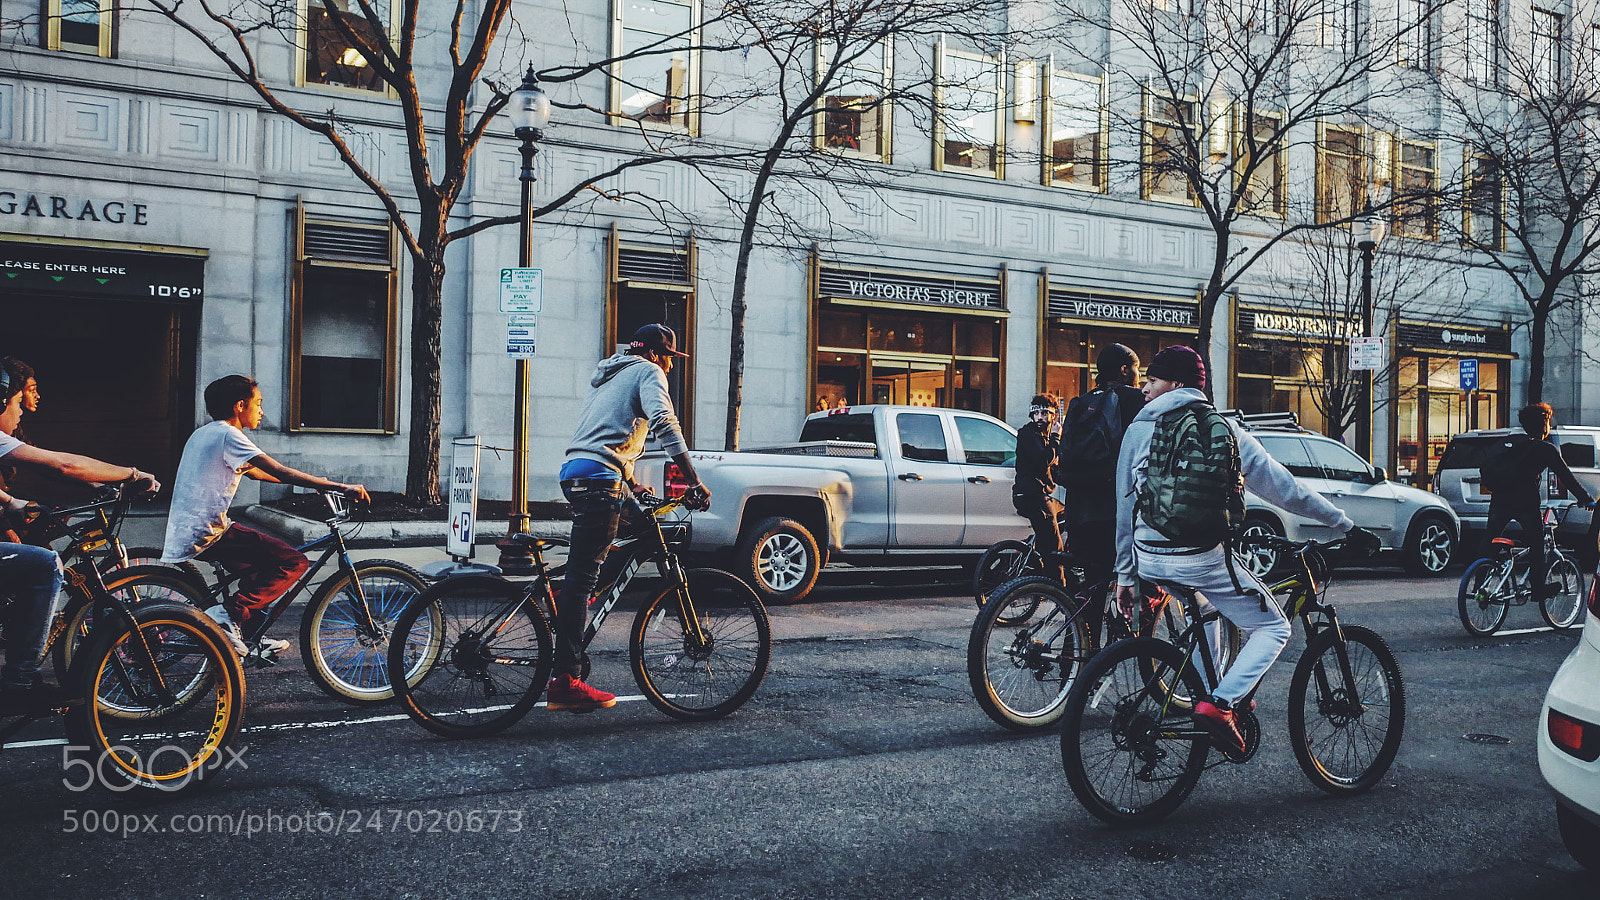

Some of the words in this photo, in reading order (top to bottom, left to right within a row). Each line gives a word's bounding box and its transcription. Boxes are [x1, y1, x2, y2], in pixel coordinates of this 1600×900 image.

[0, 192, 148, 225] GARAGE
[0, 260, 41, 270] EASE
[45, 263, 88, 272] ENTER
[92, 266, 126, 275] HERE
[502, 270, 511, 279] 2
[849, 280, 930, 301] VICTORIA'S
[940, 289, 990, 306] SECRET
[1073, 301, 1142, 320] VICTORIA'S
[1150, 308, 1192, 325] SECRET
[455, 466, 473, 483] PUBLIC
[453, 488, 471, 503] PARKING
[462, 513, 470, 541] P
[592, 558, 639, 632] FUJI
